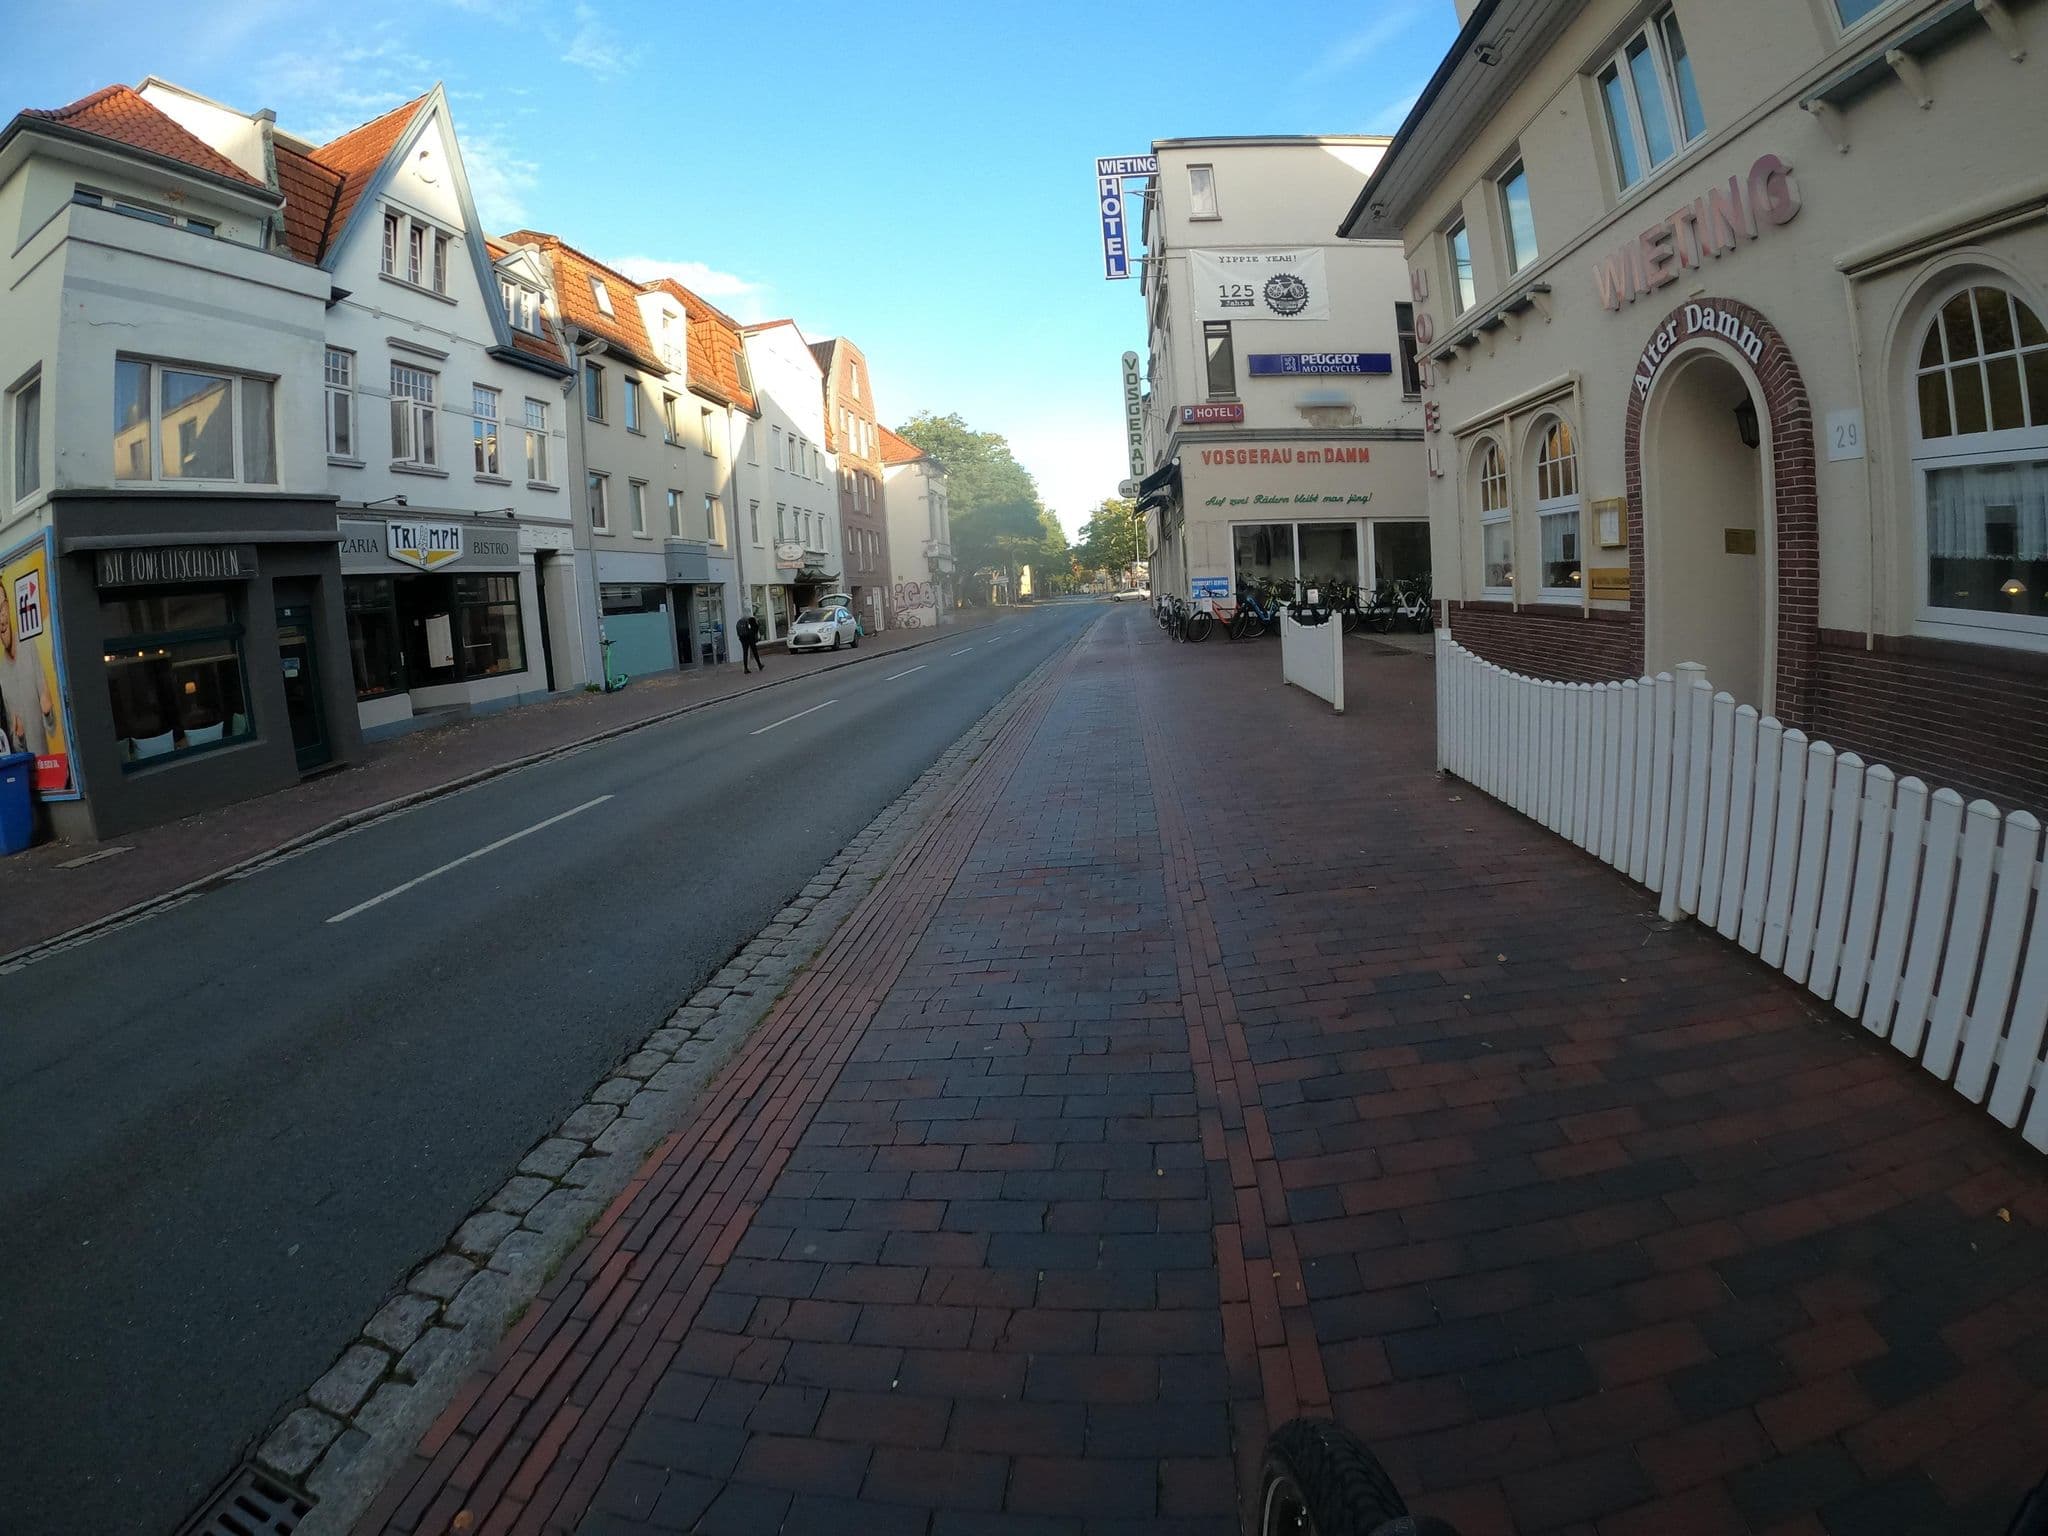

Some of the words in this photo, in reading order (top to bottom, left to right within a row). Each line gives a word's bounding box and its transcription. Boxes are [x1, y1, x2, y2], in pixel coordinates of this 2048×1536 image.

[1099, 157, 1157, 174] WIETING
[1101, 179, 1125, 276] HOTEL
[1592, 154, 1802, 311] WIETING
[1218, 255, 1259, 263] YIPPIE
[1265, 254, 1297, 262] YEAH!
[1219, 284, 1254, 298] 125
[1301, 354, 1360, 364] PEUGEOT
[1634, 319, 1678, 401] Alter
[1684, 303, 1763, 365] Damm
[1302, 365, 1361, 373] MOTOCYCLES
[1124, 358, 1145, 476] VOSGERAU
[1184, 408, 1193, 419] P
[1197, 407, 1234, 418] HOTEL
[1836, 423, 1857, 448] 29
[1201, 448, 1292, 465] VOSGERAU
[1296, 450, 1321, 463] am
[1323, 447, 1371, 463] DAMM
[1205, 496, 1227, 506] Auf
[1230, 496, 1250, 506] zwei
[1253, 494, 1290, 504] Rädern
[1293, 493, 1319, 503] bleibt
[341, 538, 379, 553] ZARIA
[473, 541, 509, 555] BISTRO
